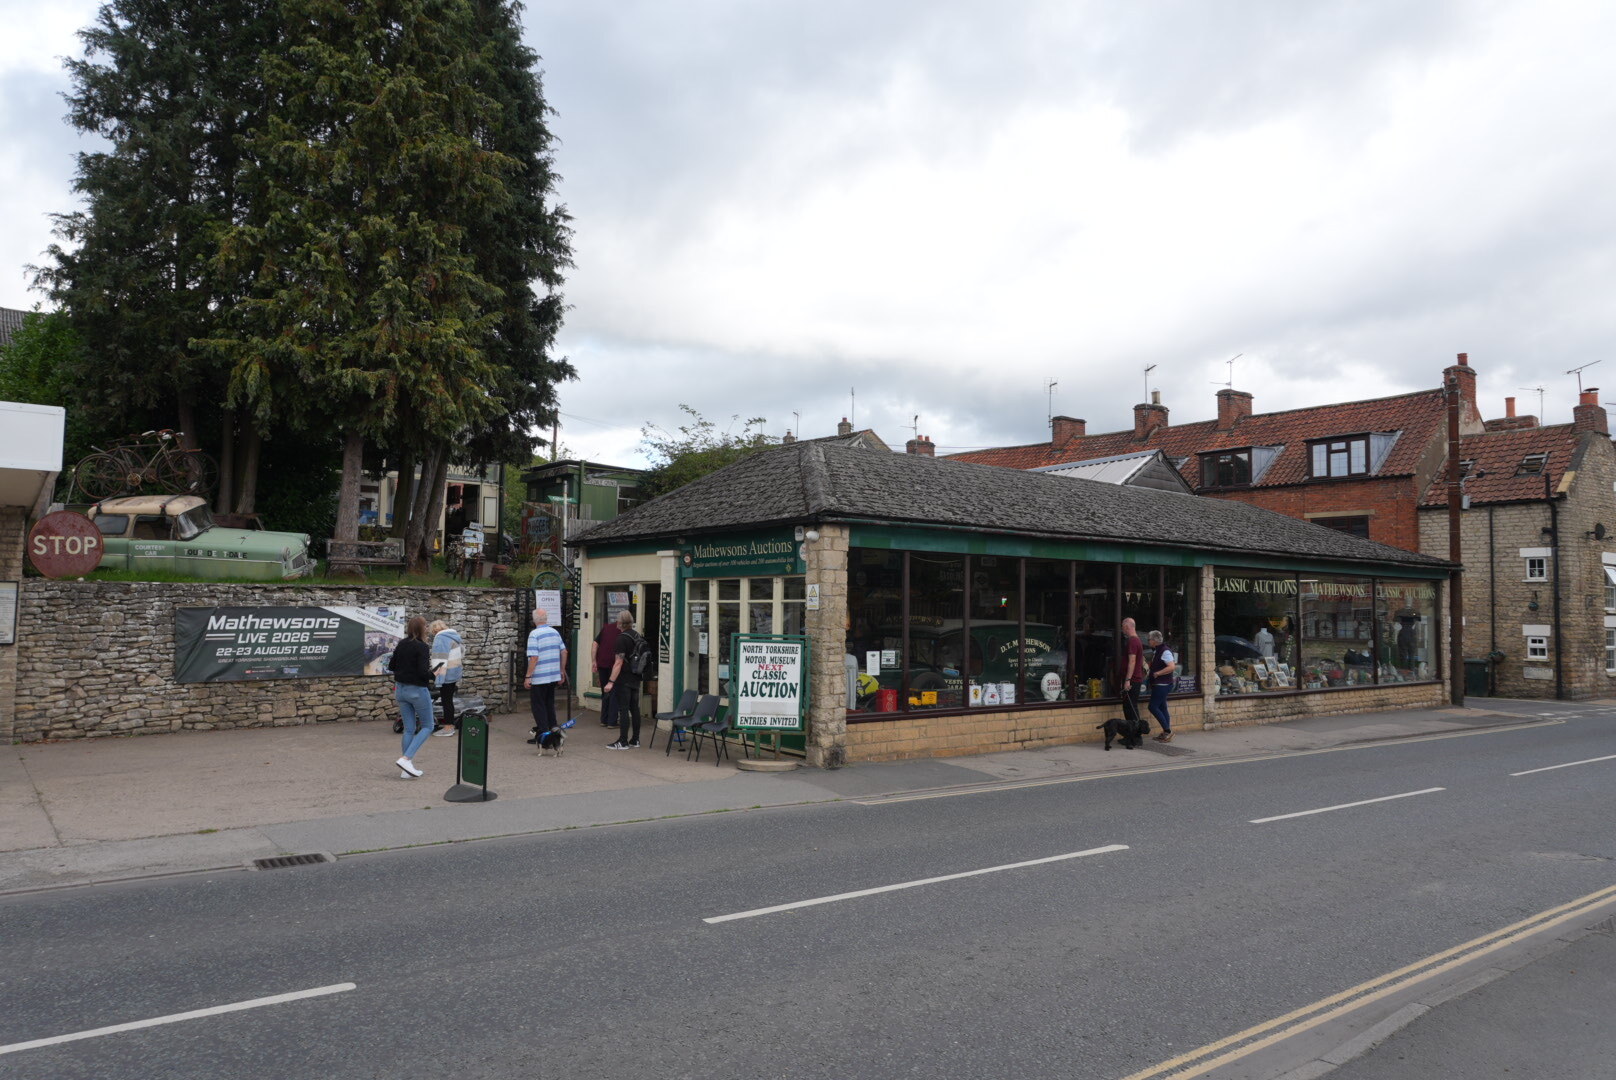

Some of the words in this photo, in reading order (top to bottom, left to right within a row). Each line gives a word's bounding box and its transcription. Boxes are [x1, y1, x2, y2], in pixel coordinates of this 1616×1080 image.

[33, 535, 98, 556] STOP
[693, 543, 748, 559] Mathewsons
[749, 539, 793, 555] Auctions
[184, 548, 203, 556] TOUR
[207, 549, 217, 558] DE
[1253, 579, 1298, 595] AUCTIONS
[1310, 582, 1366, 597] MATHEWSONS
[1404, 586, 1436, 600] AUCTIONS
[207, 614, 341, 631] Mathewsons
[237, 632, 269, 644] LIVE
[271, 632, 310, 643] 2026
[215, 646, 252, 657] 22-23
[254, 646, 299, 656] AUGUST
[299, 645, 329, 654] 2026
[742, 645, 763, 654] NORTH
[765, 645, 799, 655] YORKSHIRE
[744, 655, 767, 664] MOTOR
[769, 656, 796, 665] MUSEUM
[757, 663, 784, 671] NEXT
[752, 670, 788, 680] CLASSIC
[740, 681, 798, 698] AUCTION
[739, 716, 767, 726] ENTRIES
[769, 717, 797, 726] INVITED
